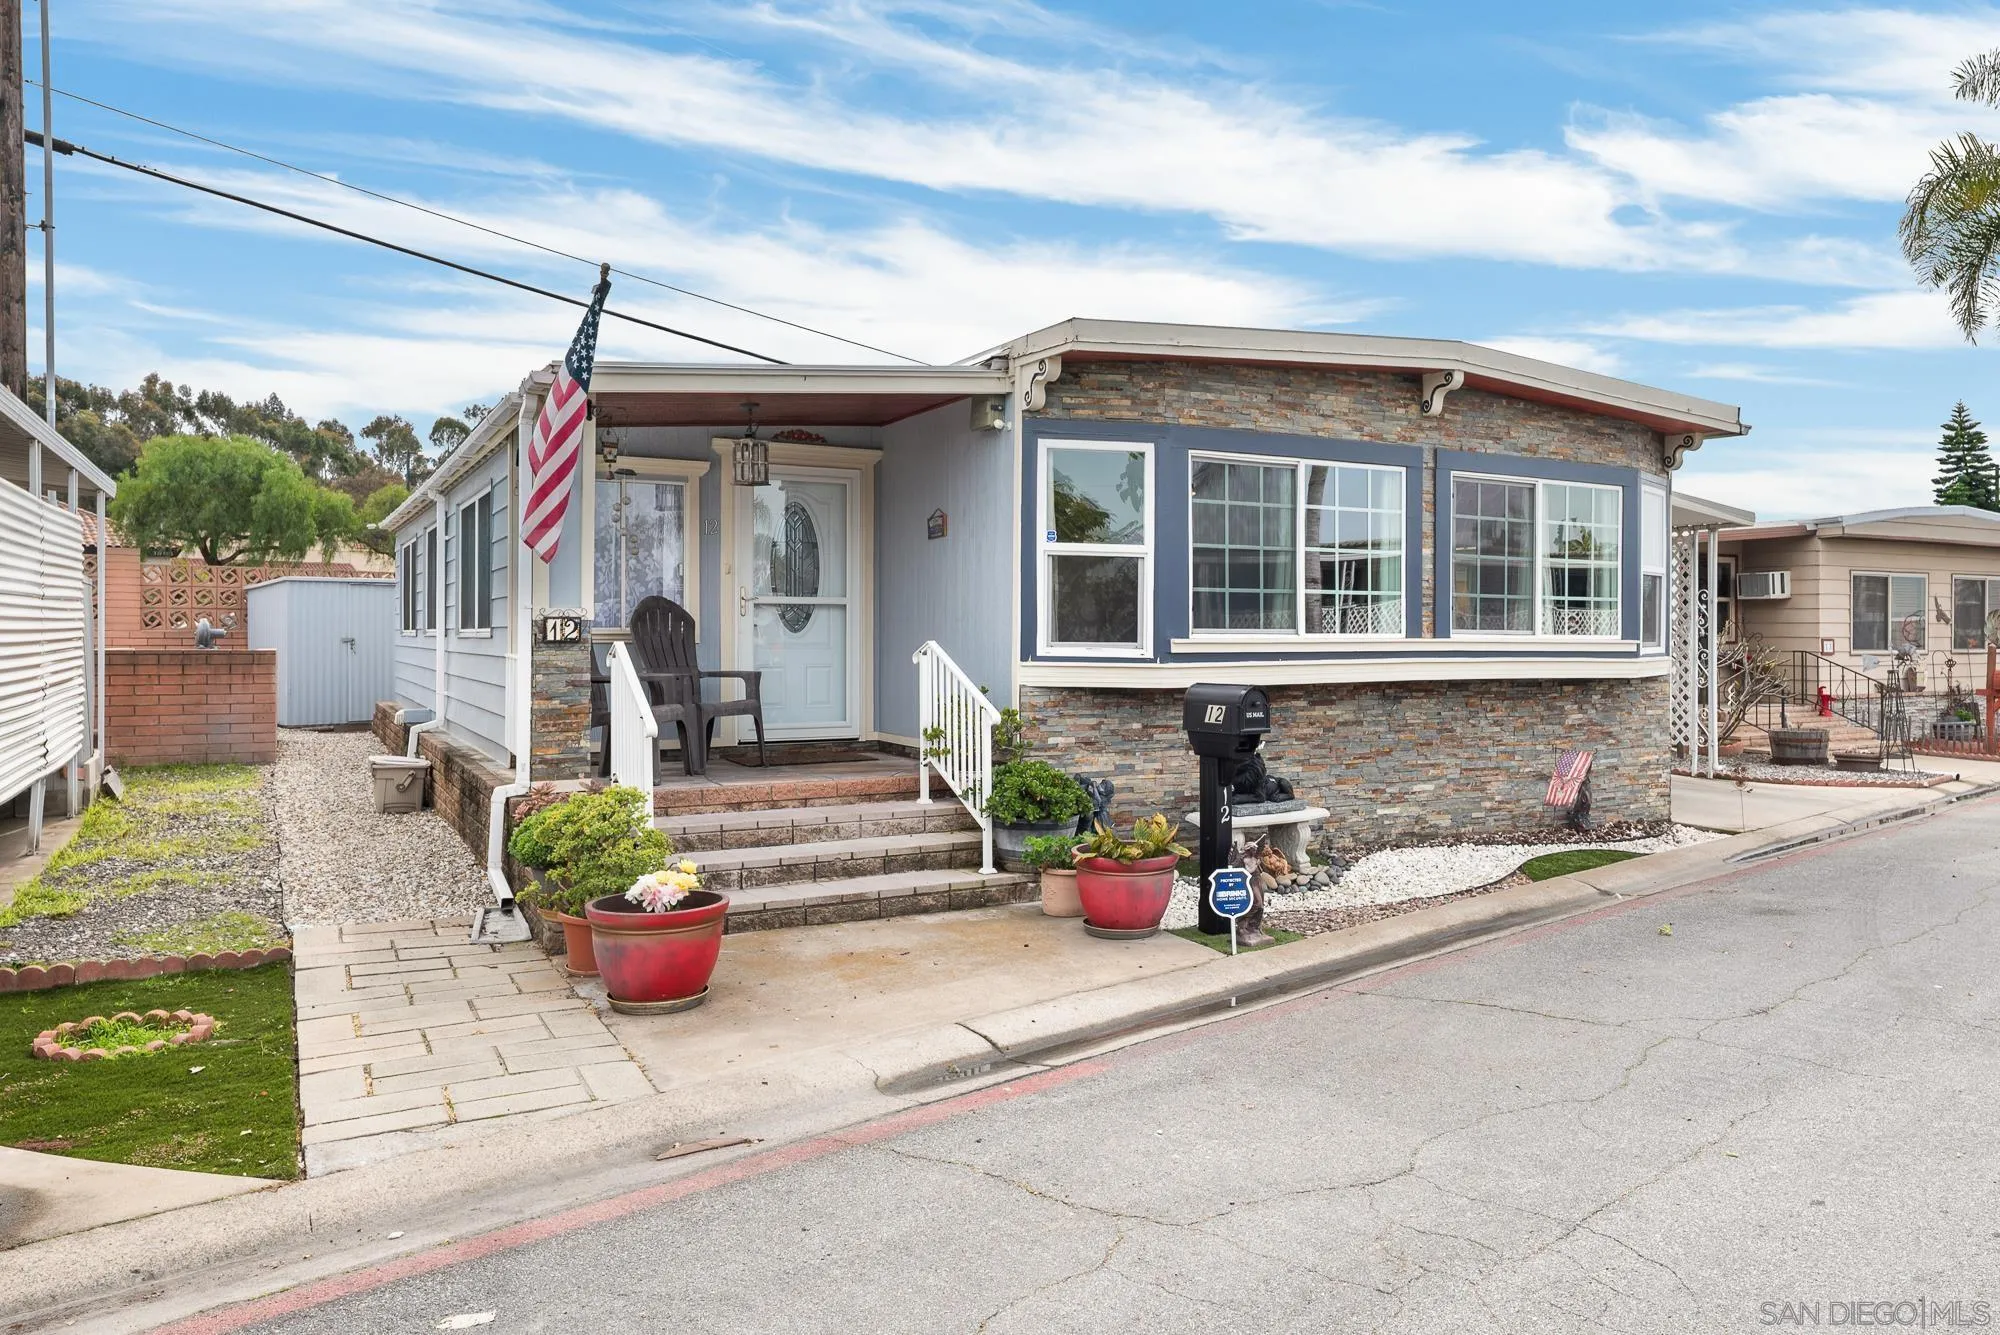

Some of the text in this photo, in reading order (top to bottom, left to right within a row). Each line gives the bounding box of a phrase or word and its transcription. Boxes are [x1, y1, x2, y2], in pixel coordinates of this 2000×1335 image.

[704, 519, 718, 535] 12
[549, 619, 579, 641] 12
[1208, 706, 1223, 722] 12
[1220, 786, 1230, 824] 12
